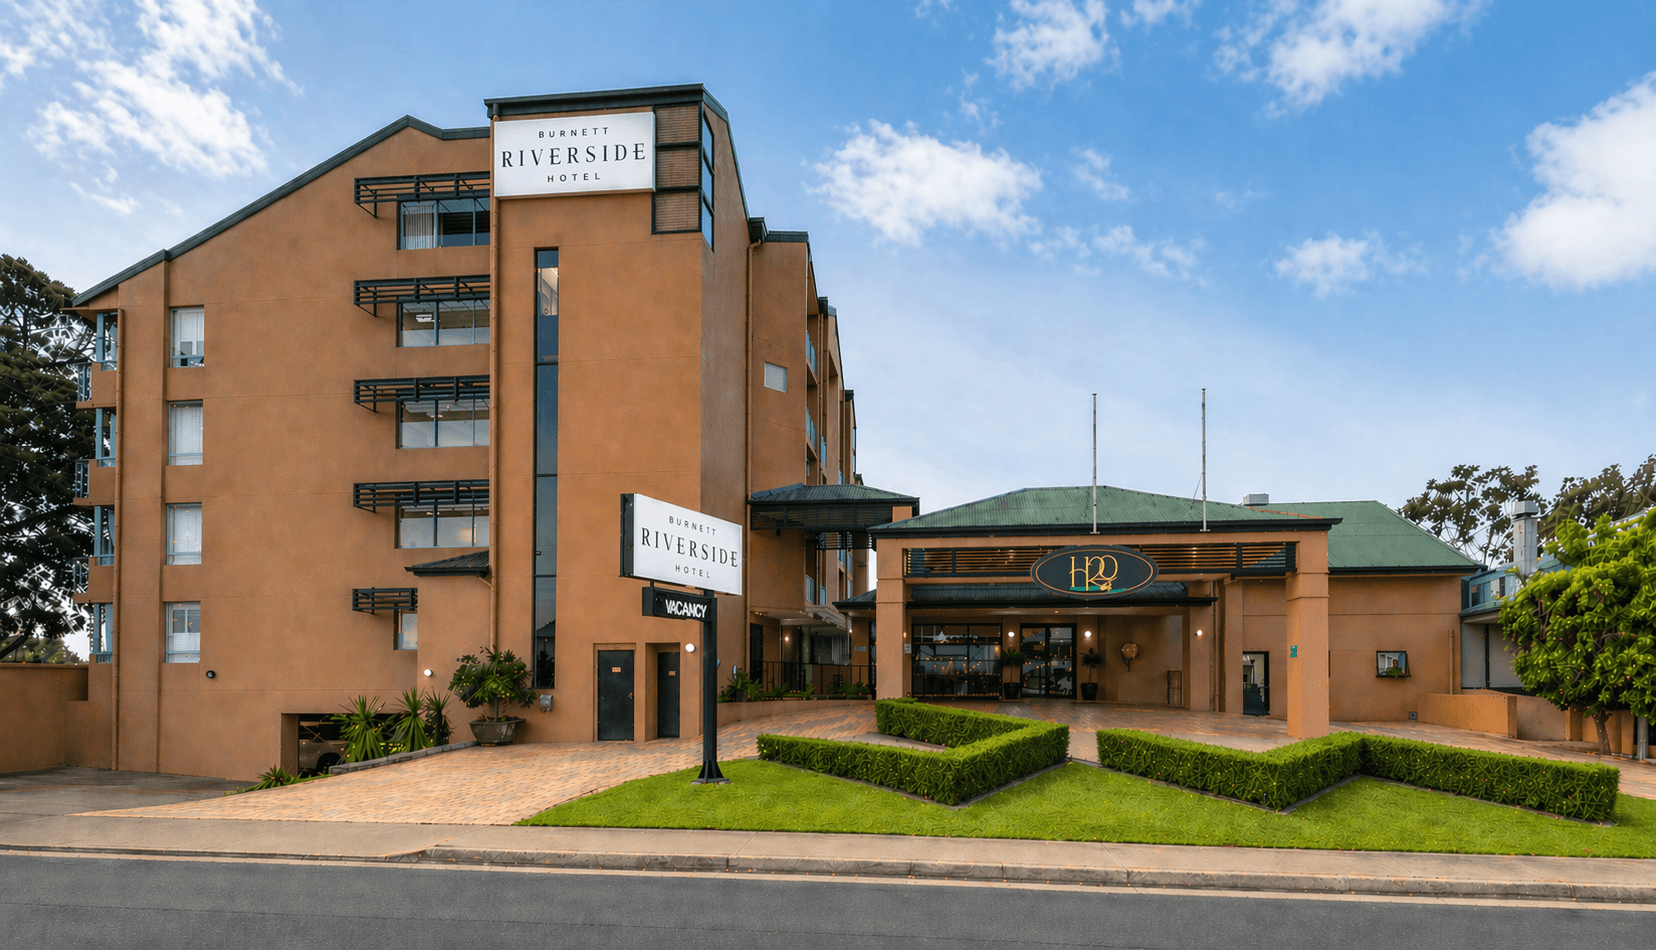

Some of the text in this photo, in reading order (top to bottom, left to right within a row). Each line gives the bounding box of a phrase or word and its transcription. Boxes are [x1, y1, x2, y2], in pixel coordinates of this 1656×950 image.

[539, 127, 609, 139] BURNETT
[501, 143, 646, 168] RIVERSIDE
[547, 172, 601, 183] HOTEL
[669, 515, 716, 536] BURNETT
[641, 527, 738, 568] RIVERSIDE
[675, 564, 710, 579] HOTEL
[665, 599, 707, 618] VACANCY
